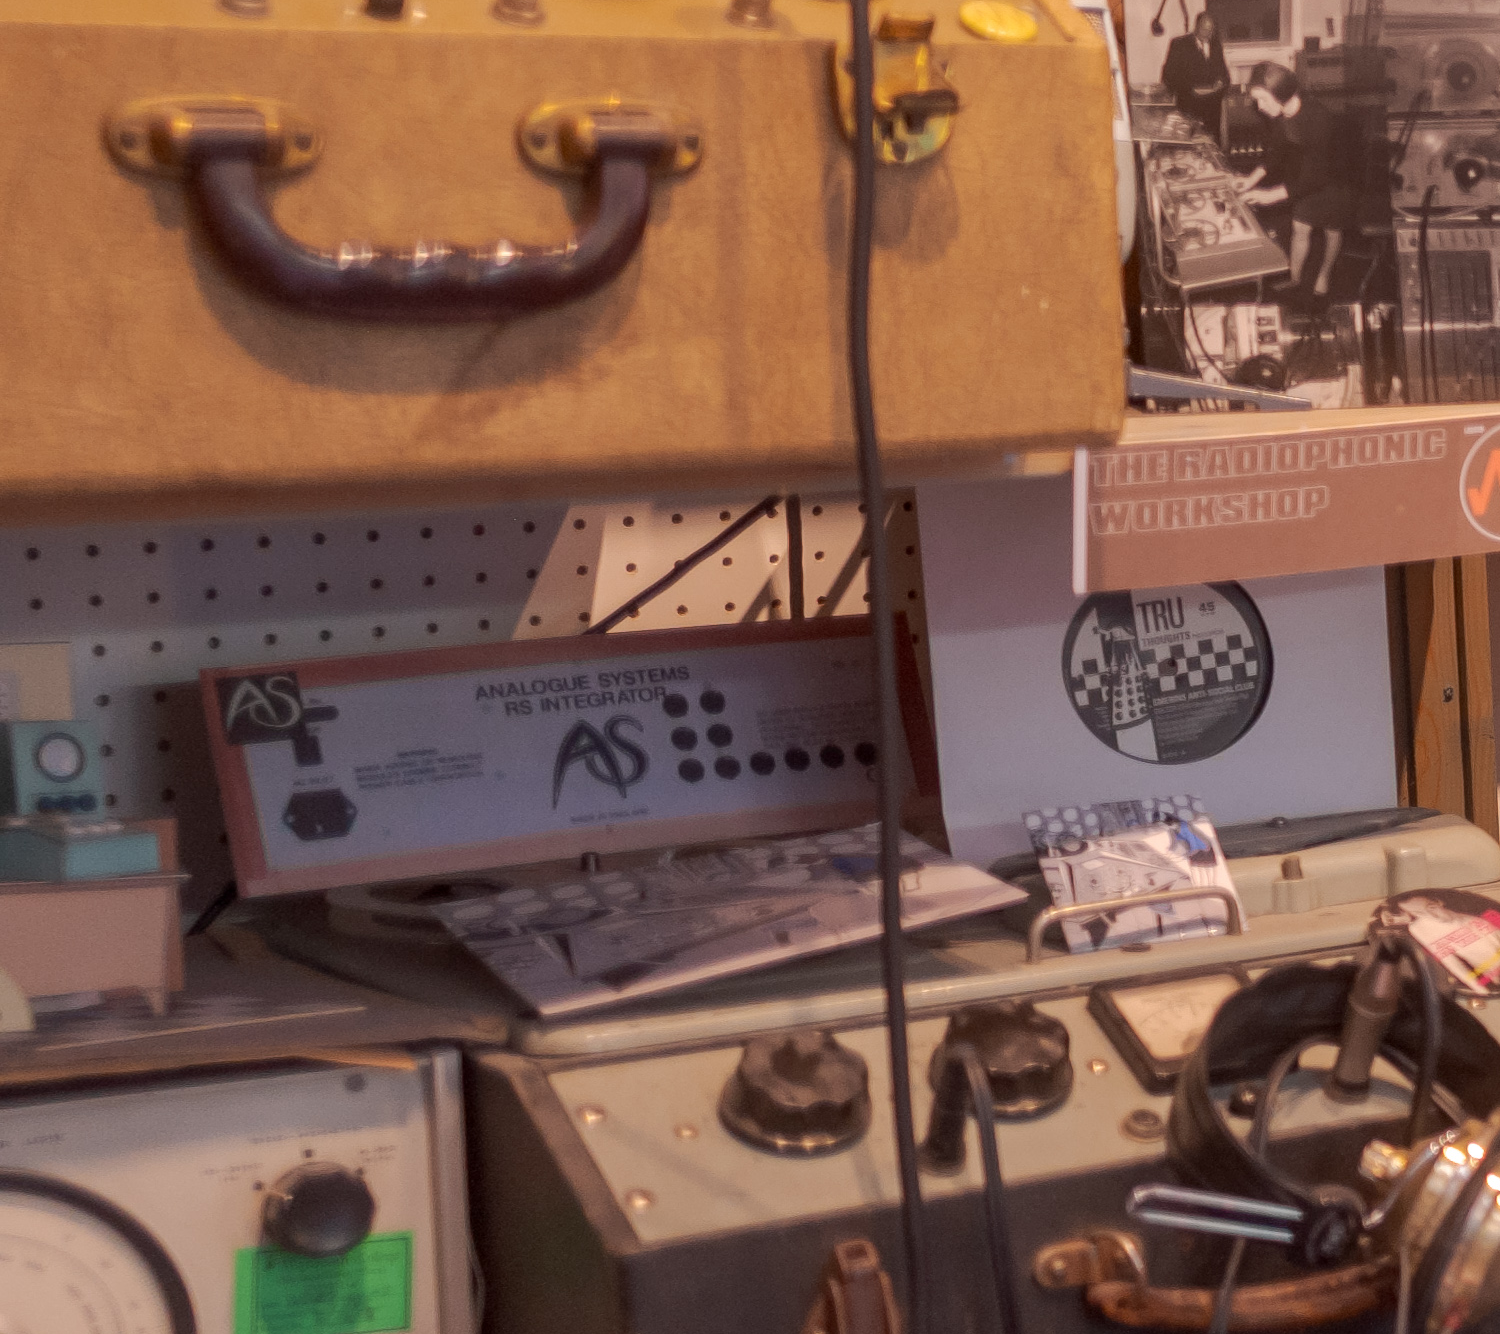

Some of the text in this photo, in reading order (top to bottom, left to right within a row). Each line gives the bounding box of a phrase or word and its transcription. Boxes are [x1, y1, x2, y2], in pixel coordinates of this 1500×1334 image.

[1091, 428, 1448, 486] THE RADIOPHONIC
[1091, 485, 1330, 535] WORKSHOP
[1137, 596, 1186, 634] TRU
[474, 666, 691, 703] ANALOGUE SYSTEMS
[504, 686, 666, 717] RS INTEGRATOR
